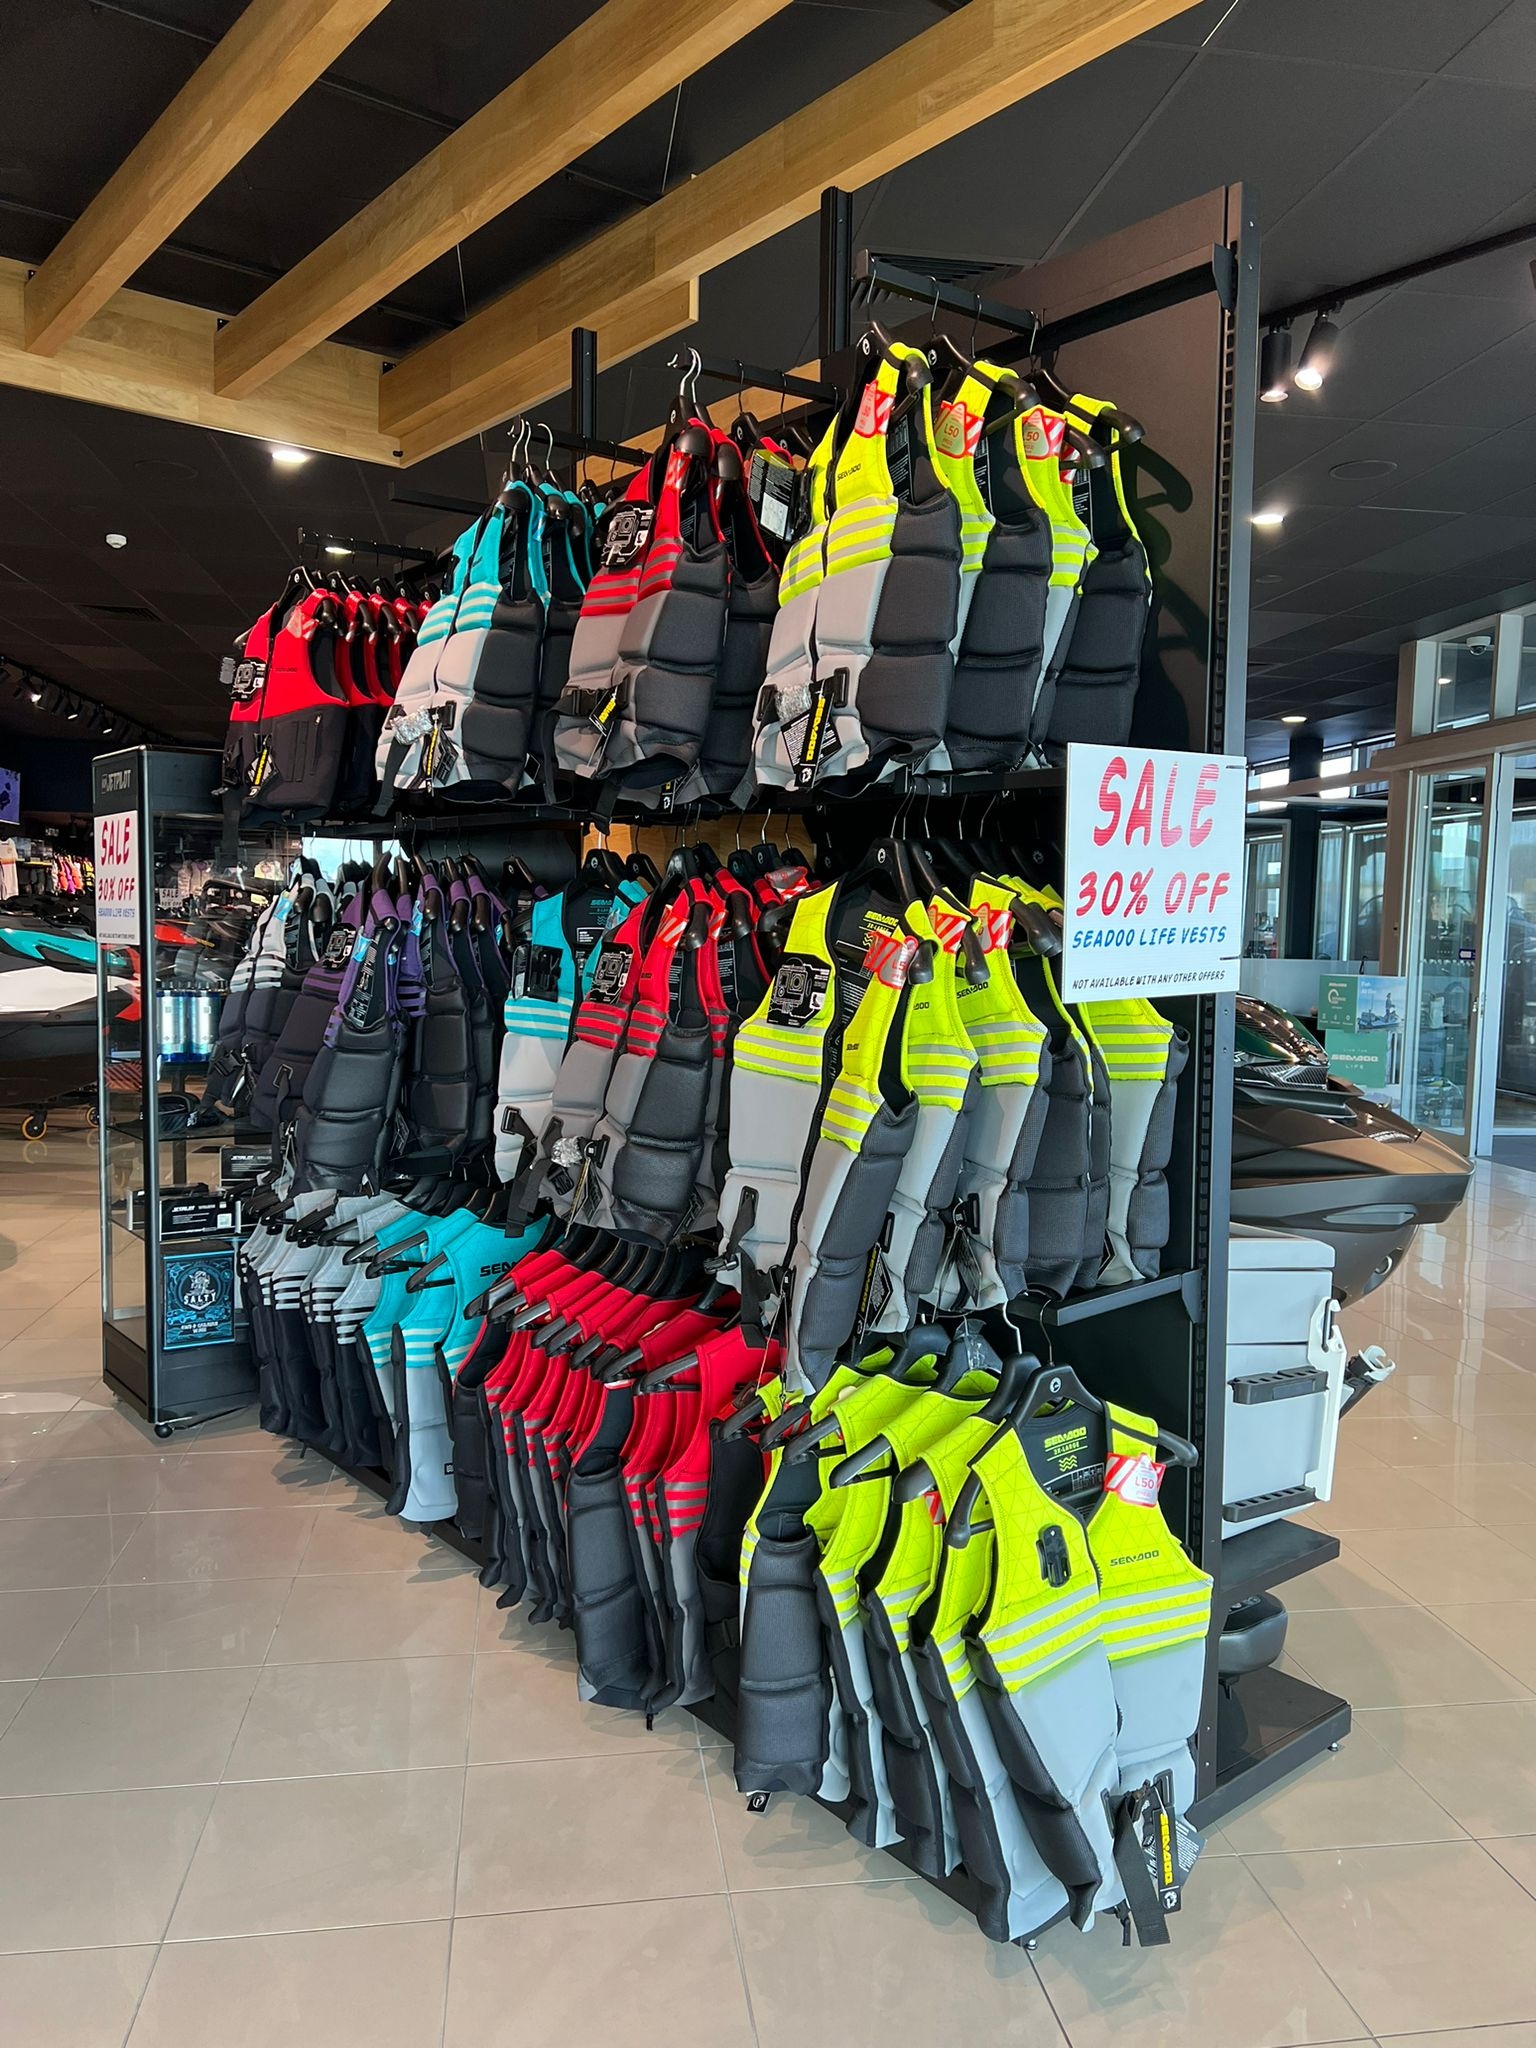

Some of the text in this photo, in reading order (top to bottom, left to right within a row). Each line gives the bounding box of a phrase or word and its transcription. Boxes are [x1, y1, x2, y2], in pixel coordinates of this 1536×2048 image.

[944, 423, 960, 438] L50
[1023, 431, 1040, 442] 50
[1093, 756, 1220, 848] SALE
[101, 817, 131, 866] SALE
[98, 876, 135, 901] 30% OFF
[1075, 867, 1231, 918] 30% OFF
[1072, 925, 1228, 948] SEADOO LIFE VESTS
[1072, 970, 1226, 989] NOT AVAILABLE WITH ANY OTHER OFFERS
[183, 1291, 216, 1305] SALTY
[1135, 1475, 1155, 1489] L50
